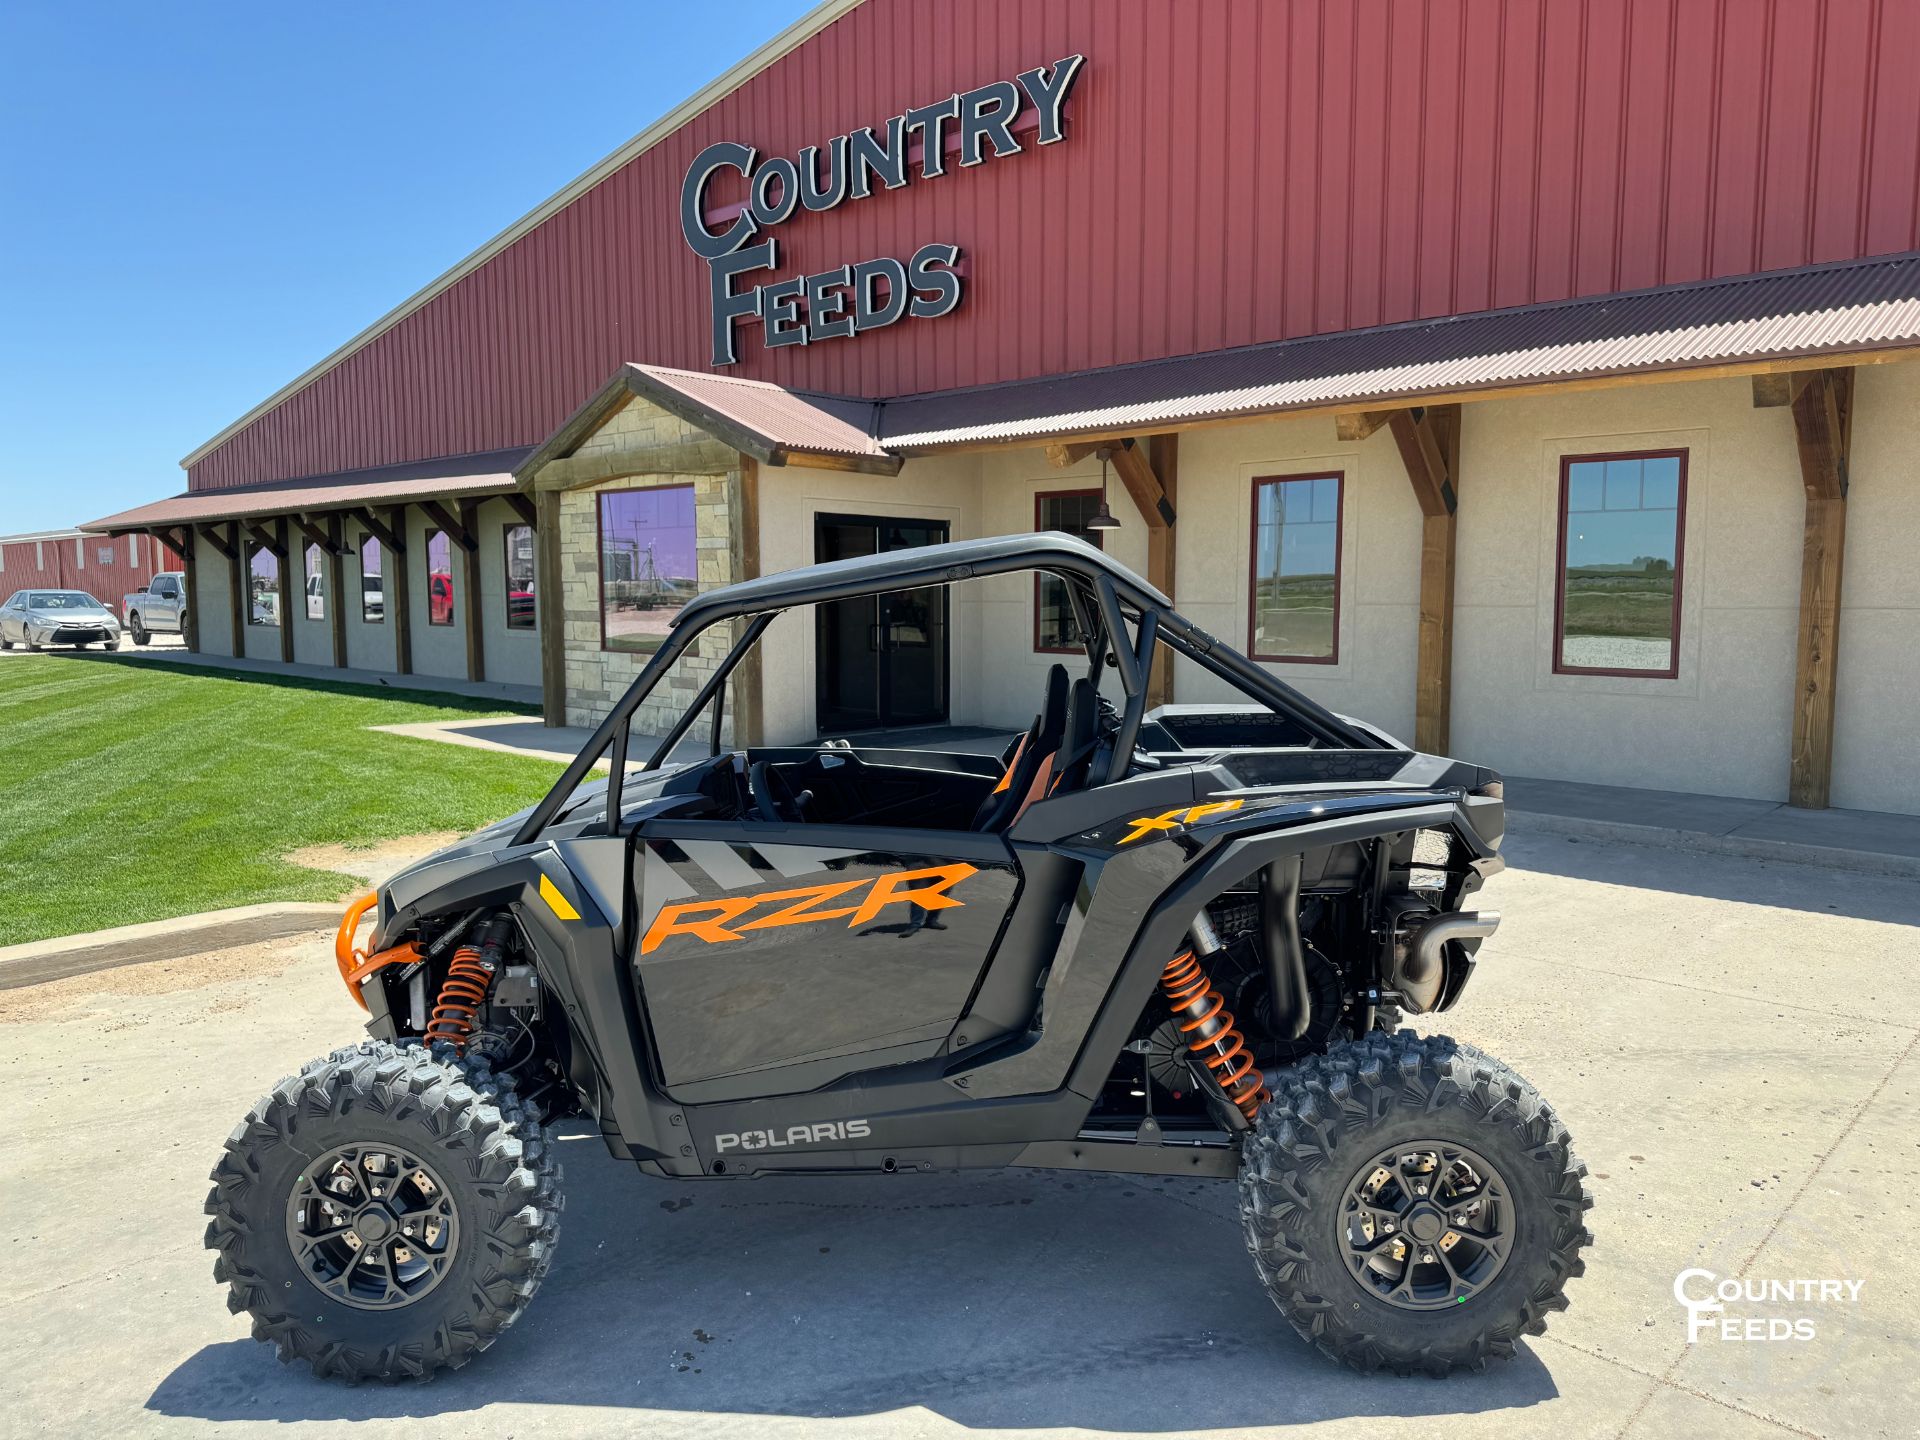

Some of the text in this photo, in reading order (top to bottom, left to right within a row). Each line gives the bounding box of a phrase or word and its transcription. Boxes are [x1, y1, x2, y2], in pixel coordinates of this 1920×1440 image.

[680, 54, 1087, 259] COUNTRY
[707, 237, 963, 367] FEEDS
[1115, 799, 1245, 846] XP
[641, 862, 979, 955] RZR
[715, 1119, 871, 1153] POLARIS
